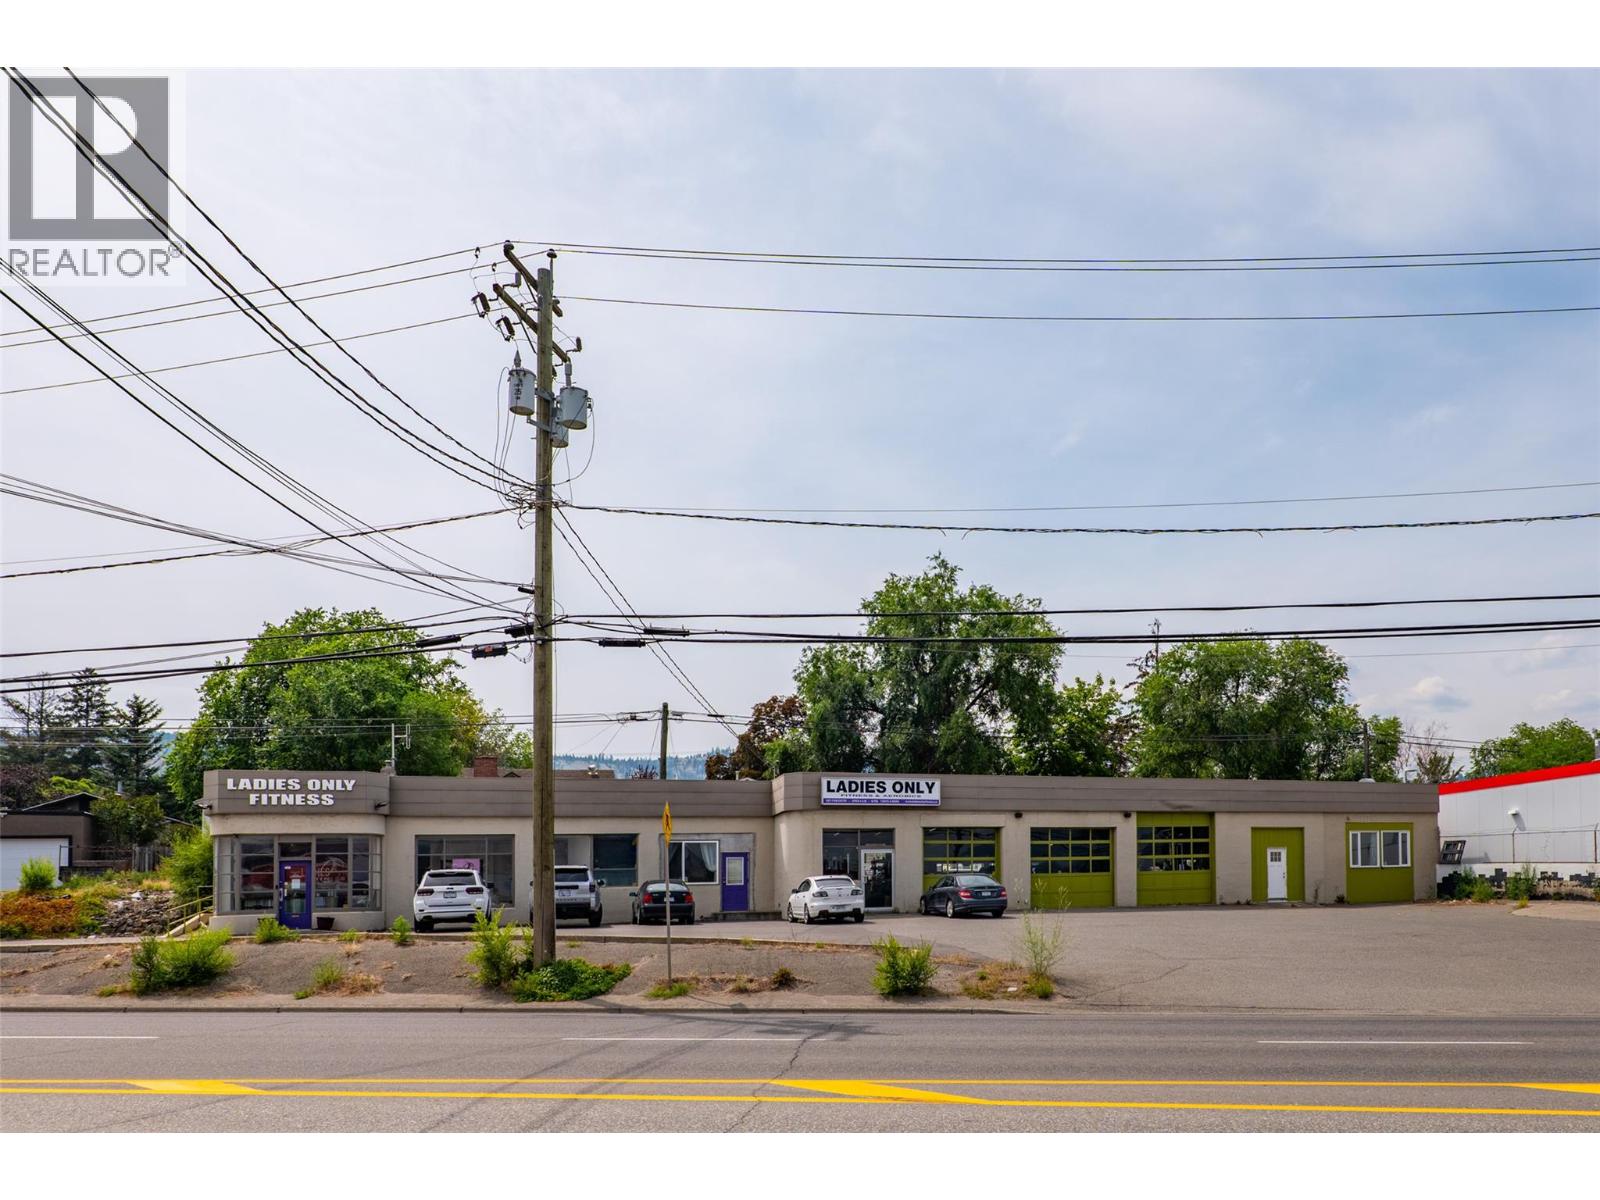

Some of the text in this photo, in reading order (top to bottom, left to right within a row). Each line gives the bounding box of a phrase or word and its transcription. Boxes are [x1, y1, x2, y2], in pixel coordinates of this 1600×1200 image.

[226, 778, 356, 791] LADIES ONLY
[826, 780, 935, 794] LADIES ONLY
[249, 793, 335, 806] FITNESS
